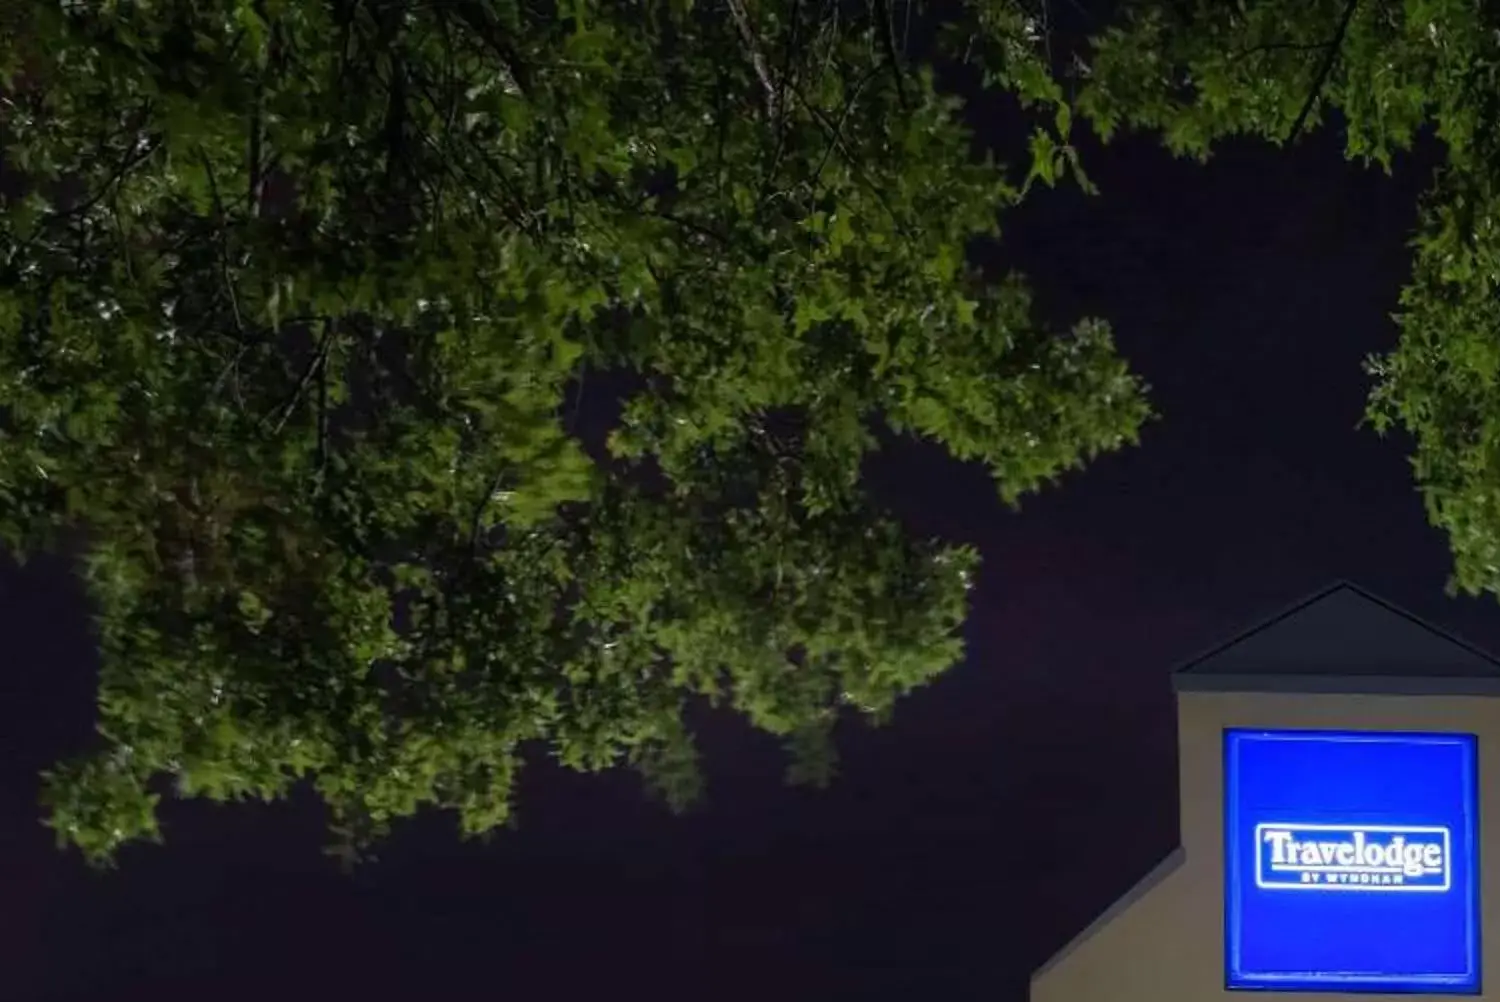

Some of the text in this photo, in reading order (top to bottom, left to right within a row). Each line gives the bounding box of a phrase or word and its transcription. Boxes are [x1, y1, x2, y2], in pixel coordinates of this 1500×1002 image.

[1264, 831, 1442, 876] Travelodge
[1301, 872, 1404, 885] BY WYNDHAM
